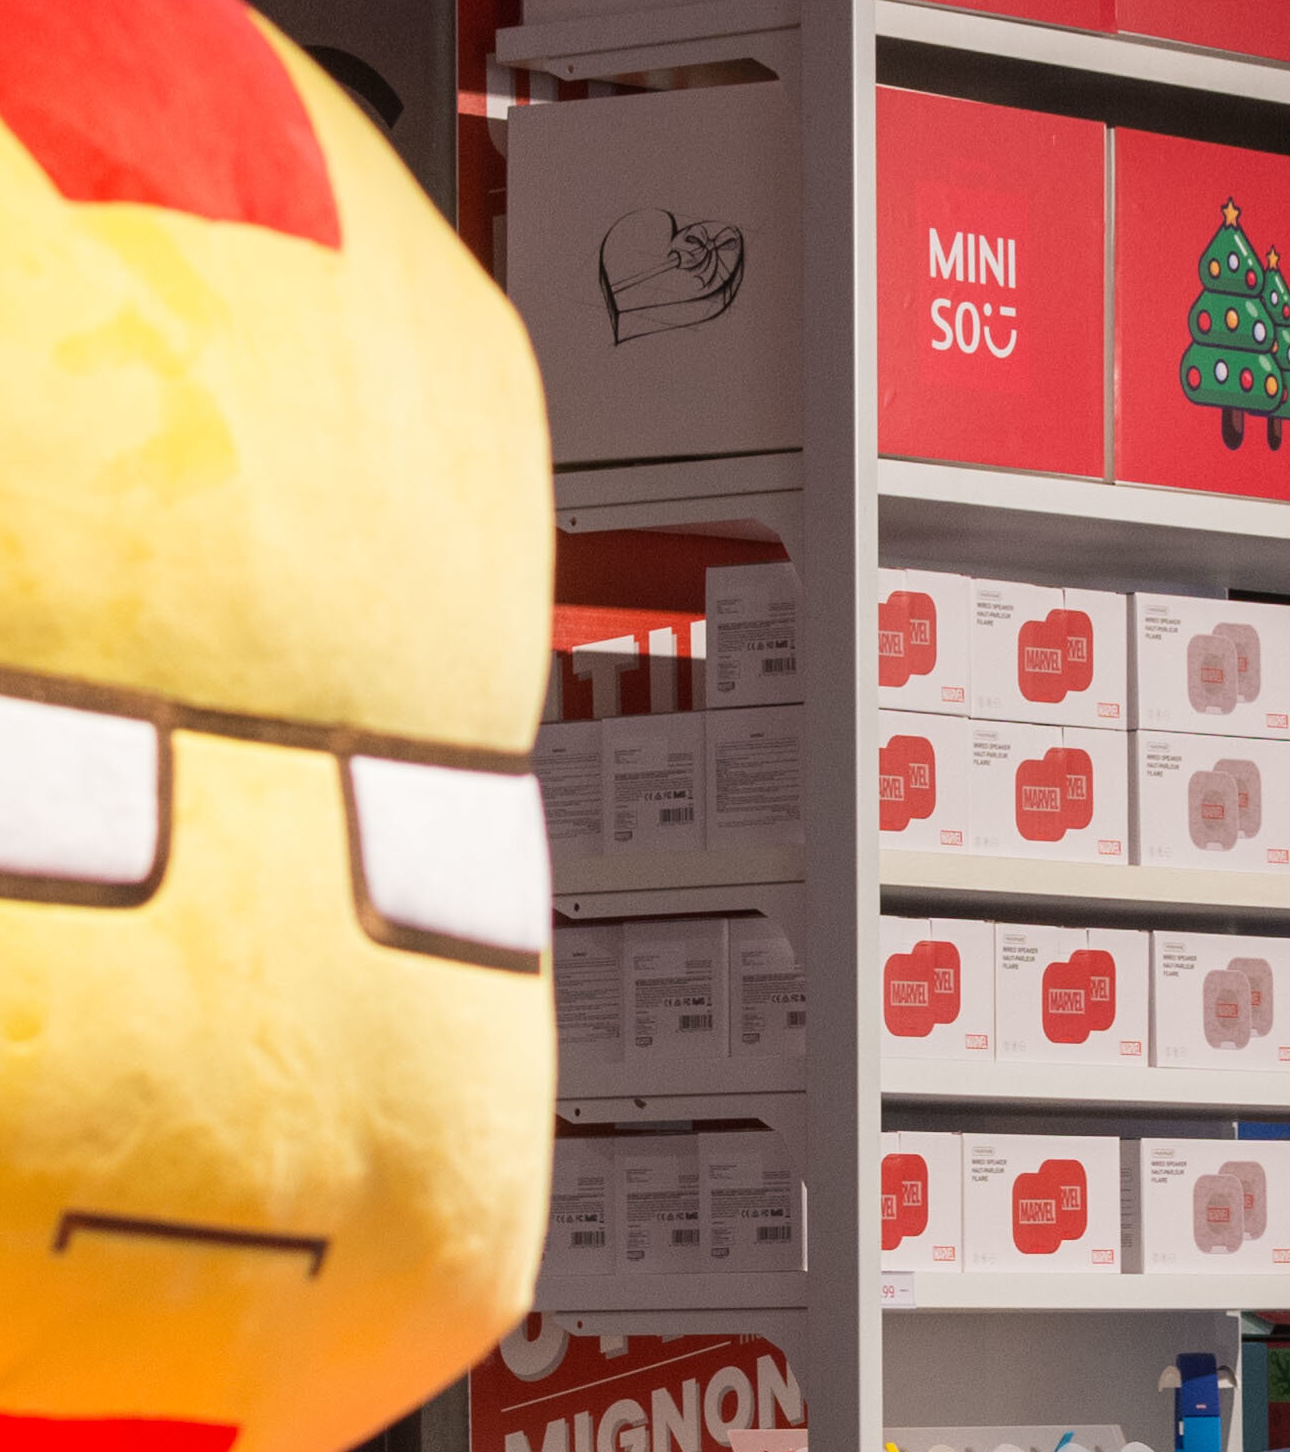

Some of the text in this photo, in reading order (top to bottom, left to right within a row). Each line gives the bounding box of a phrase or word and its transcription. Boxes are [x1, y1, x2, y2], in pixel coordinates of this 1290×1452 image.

[928, 227, 1017, 289] MINI
[879, 633, 903, 655] ARVEL
[1026, 649, 1060, 671] MARVEL
[880, 778, 903, 799] ARVEL
[1024, 788, 1059, 810] MARVEL
[892, 983, 927, 1005] MARVEL
[1050, 991, 1083, 1012] MARVEL
[1020, 1201, 1055, 1223] MARVEL
